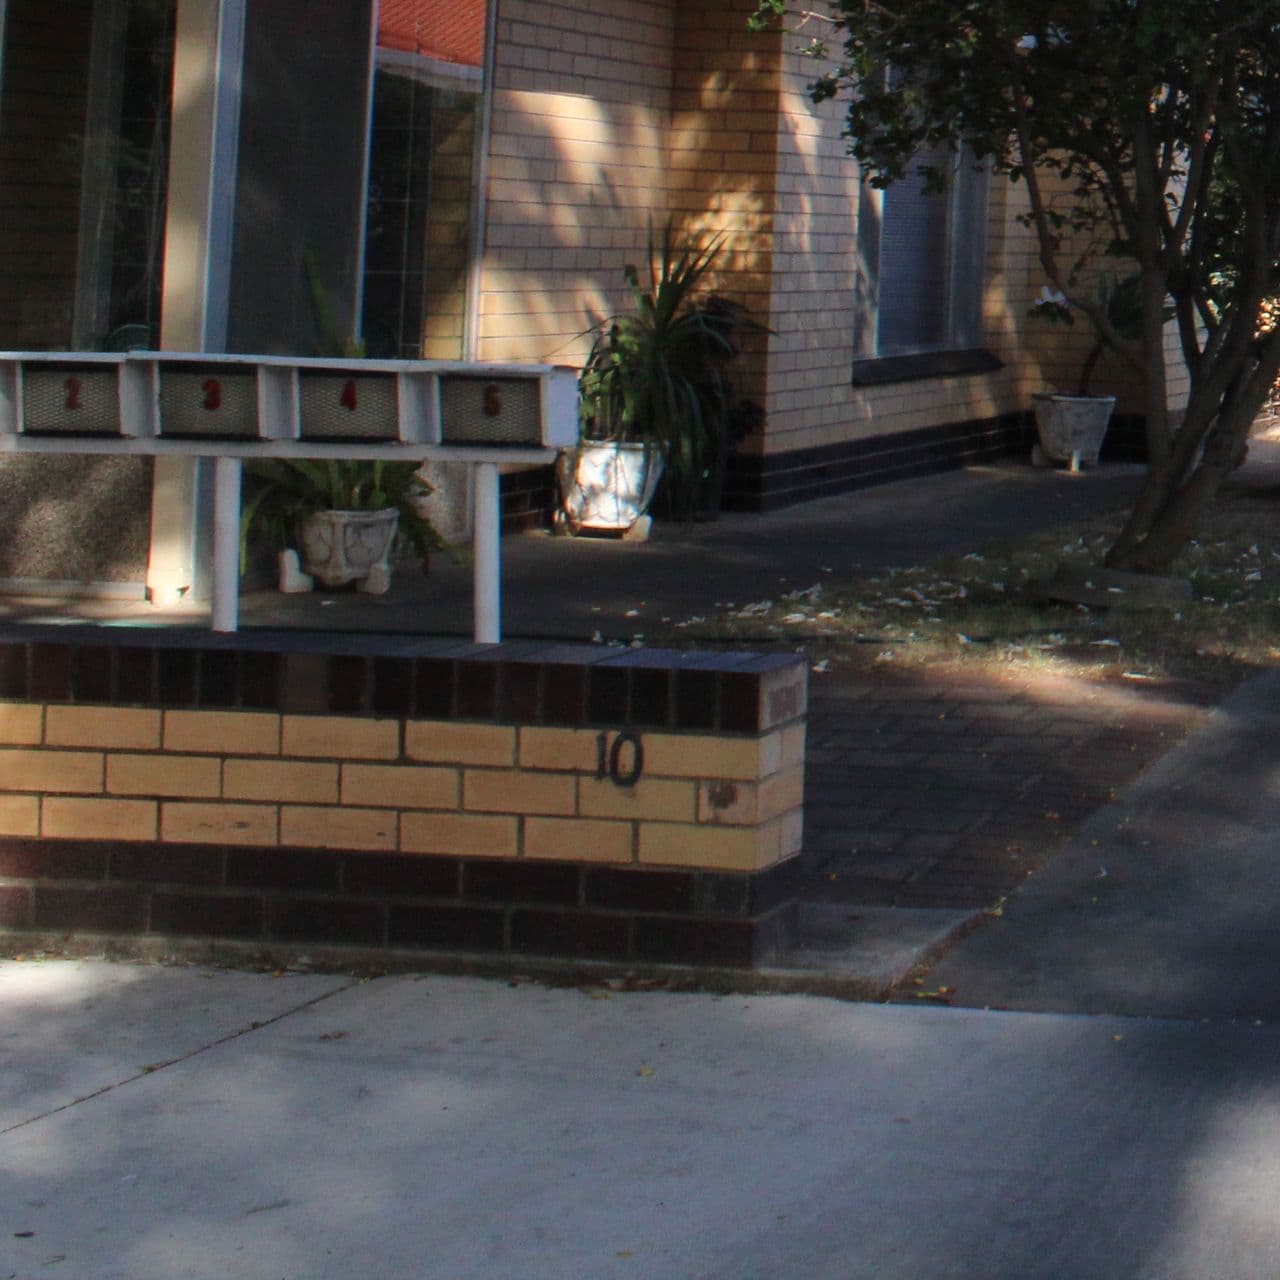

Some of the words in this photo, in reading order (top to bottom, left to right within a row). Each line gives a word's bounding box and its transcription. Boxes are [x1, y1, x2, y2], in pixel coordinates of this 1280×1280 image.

[64, 377, 81, 410] 2
[202, 378, 221, 410] 3
[340, 379, 357, 411] 4
[596, 732, 644, 787] 10
